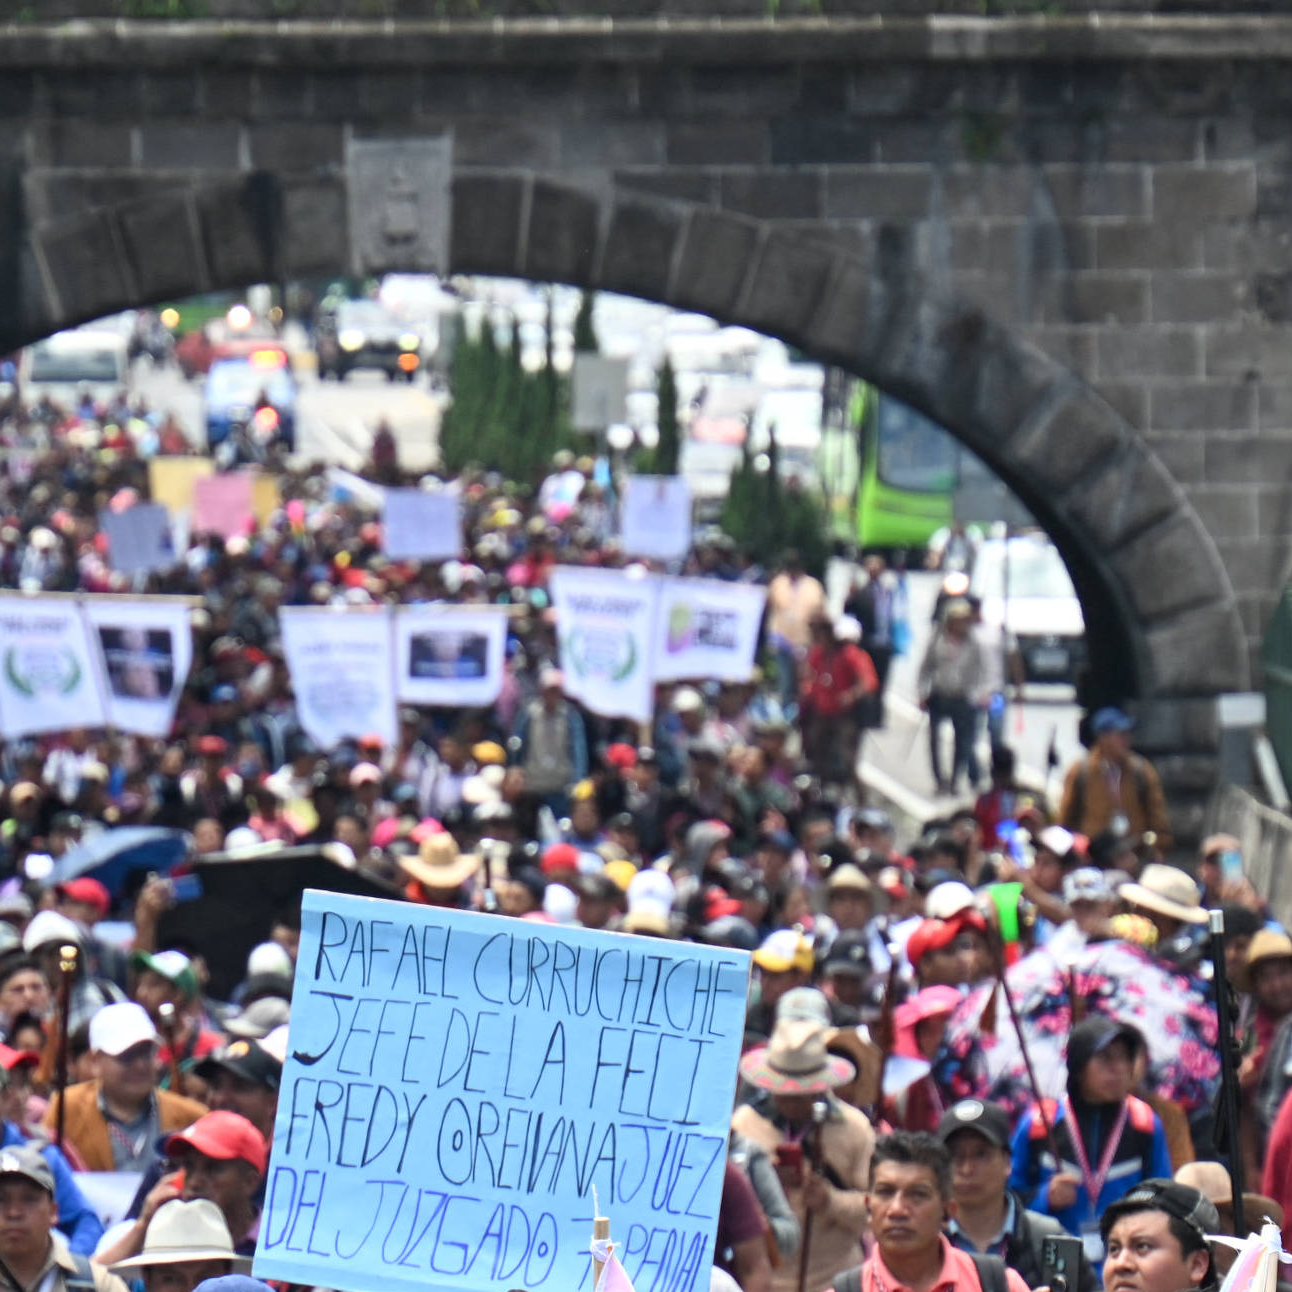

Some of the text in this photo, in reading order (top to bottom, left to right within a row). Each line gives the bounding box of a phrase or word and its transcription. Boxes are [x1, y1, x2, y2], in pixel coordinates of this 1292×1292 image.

[314, 911, 737, 1037] RAFAEL CURRUCHICHE
[292, 990, 431, 1082] JEFE
[589, 1026, 715, 1126] FECI
[286, 1077, 428, 1174] FREDY
[618, 1123, 724, 1219] JUEZ
[264, 1166, 330, 1257] DEL
[336, 1180, 558, 1288] JUZGADO
